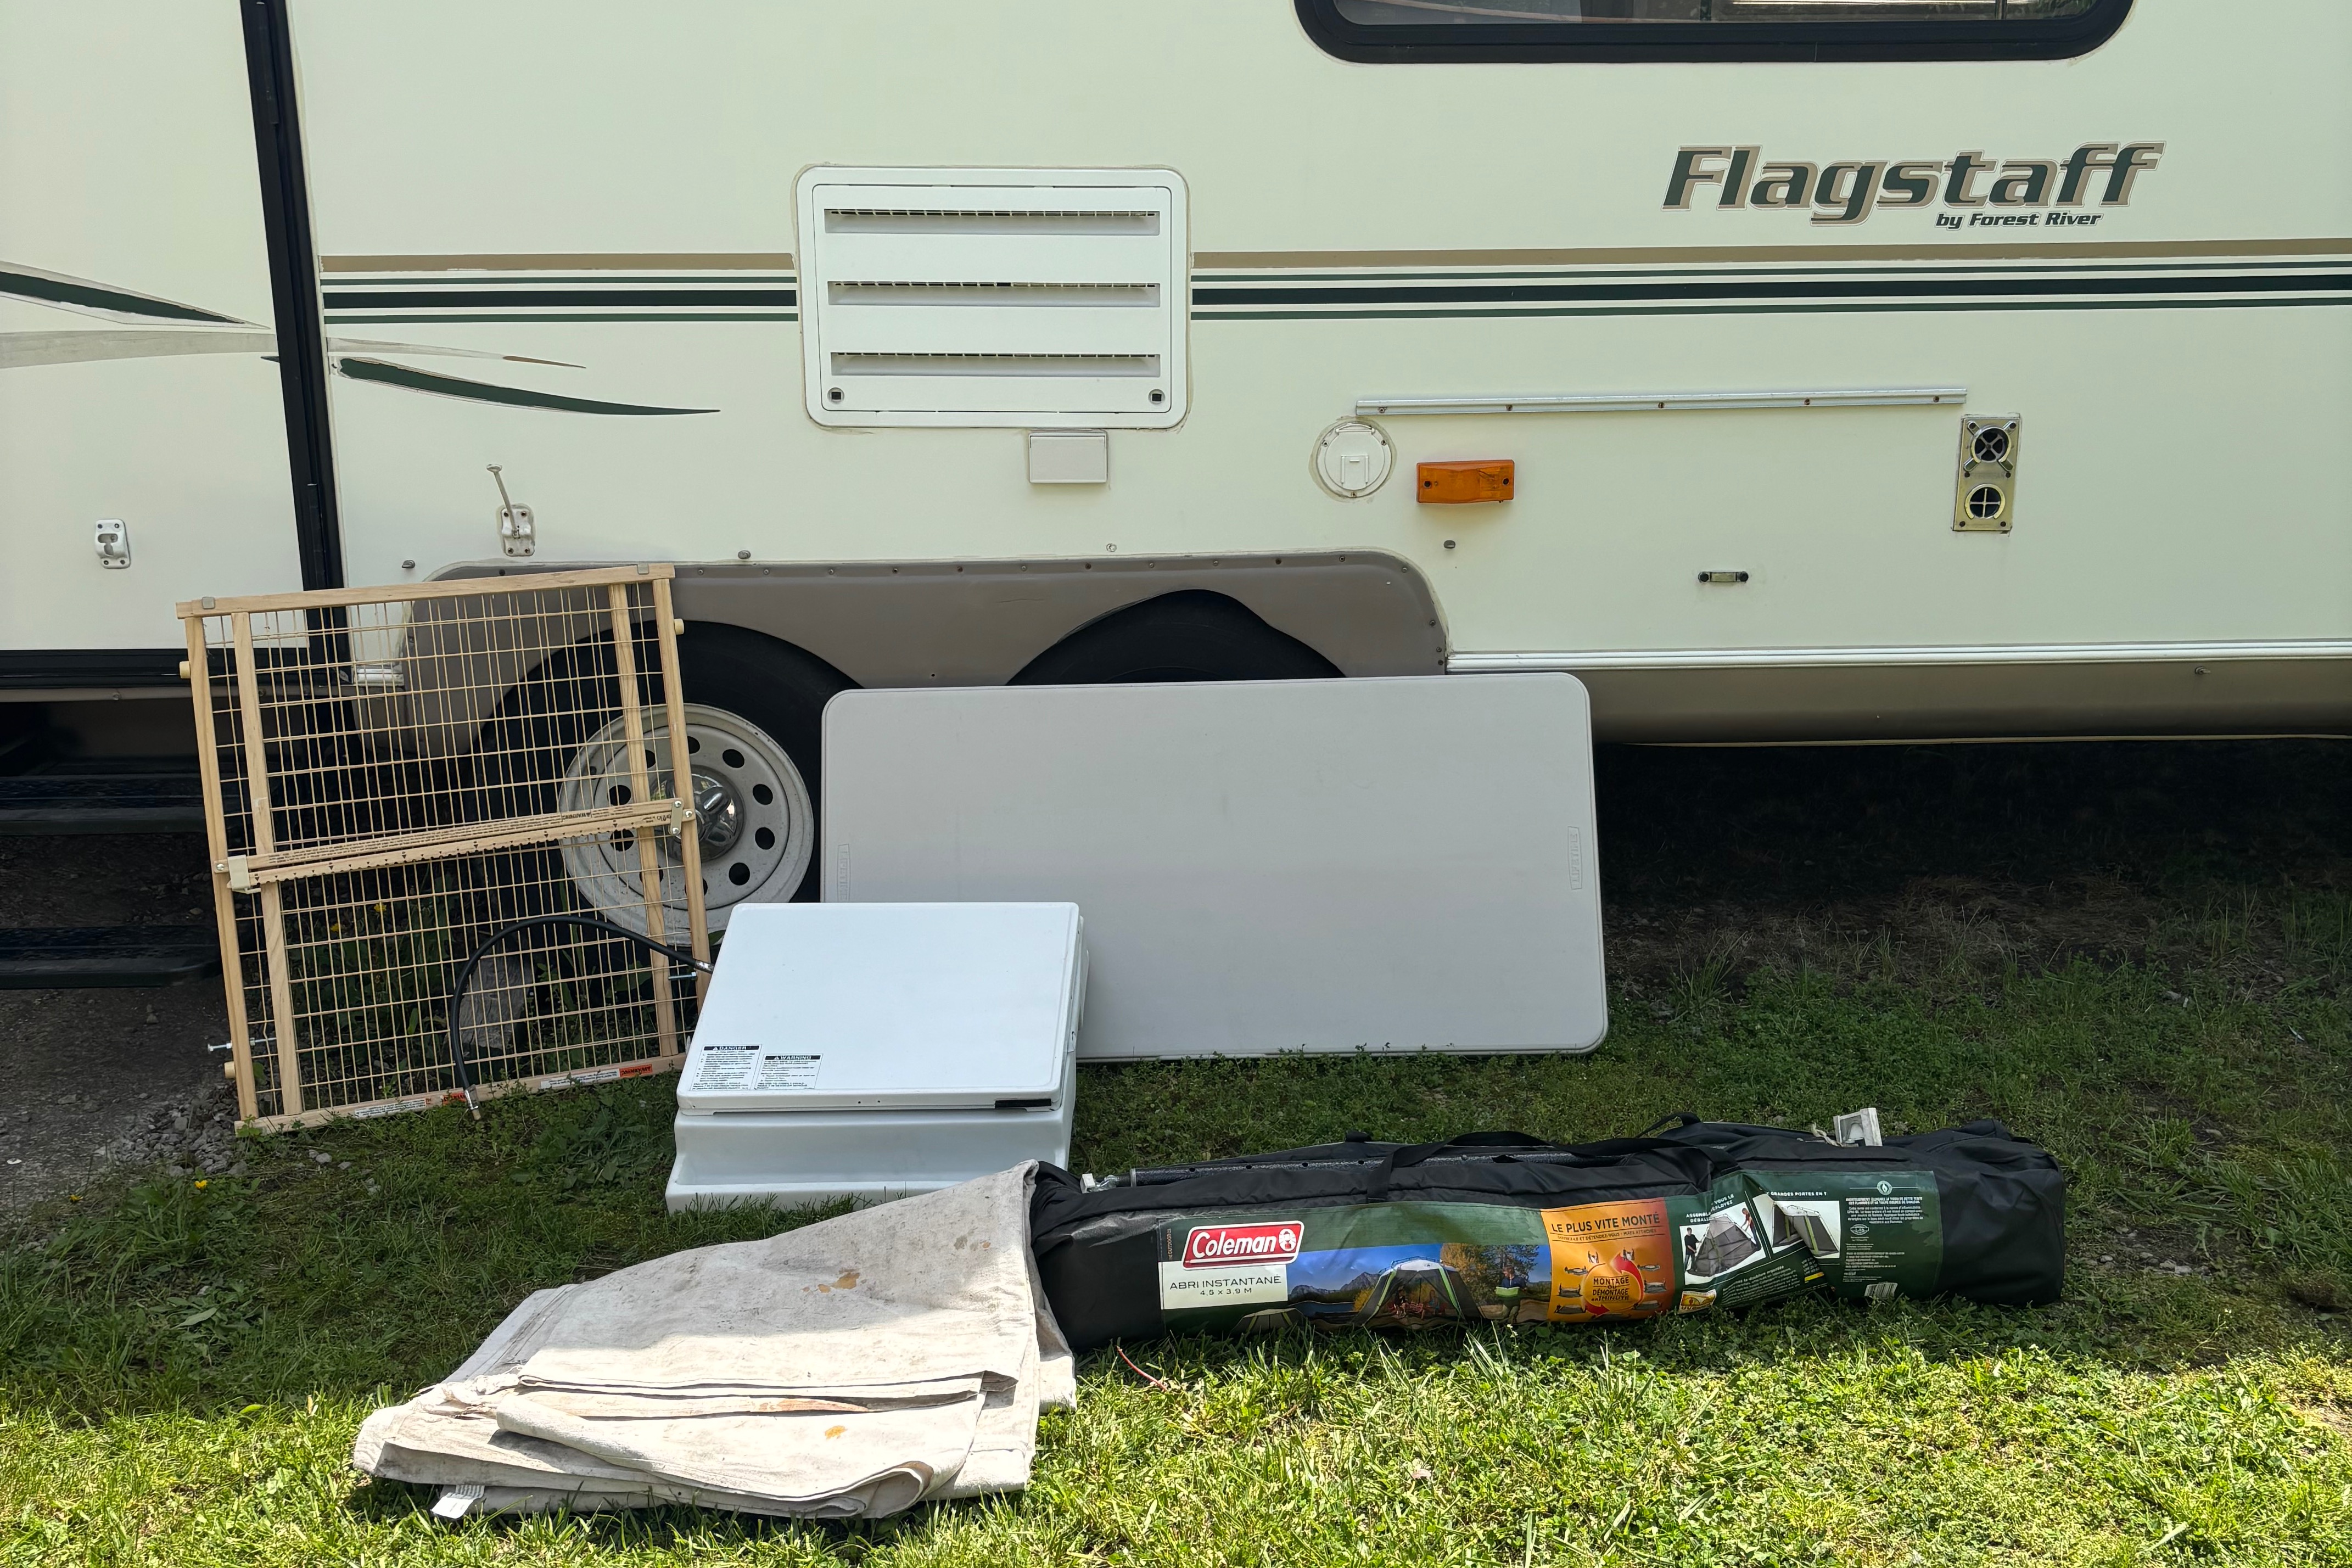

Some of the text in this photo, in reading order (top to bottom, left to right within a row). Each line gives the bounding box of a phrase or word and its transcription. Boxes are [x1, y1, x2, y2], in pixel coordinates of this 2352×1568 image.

[1661, 141, 2165, 226] Flagstaff
[1936, 212, 2102, 229] by Forest River
[1551, 1212, 1661, 1234] LE PLUS VITE MONTÉ
[1192, 1231, 1277, 1259] Coleman
[1169, 1274, 1283, 1290] ABRI INSTANTANÉ
[1593, 1276, 1629, 1285] MONTAGE
